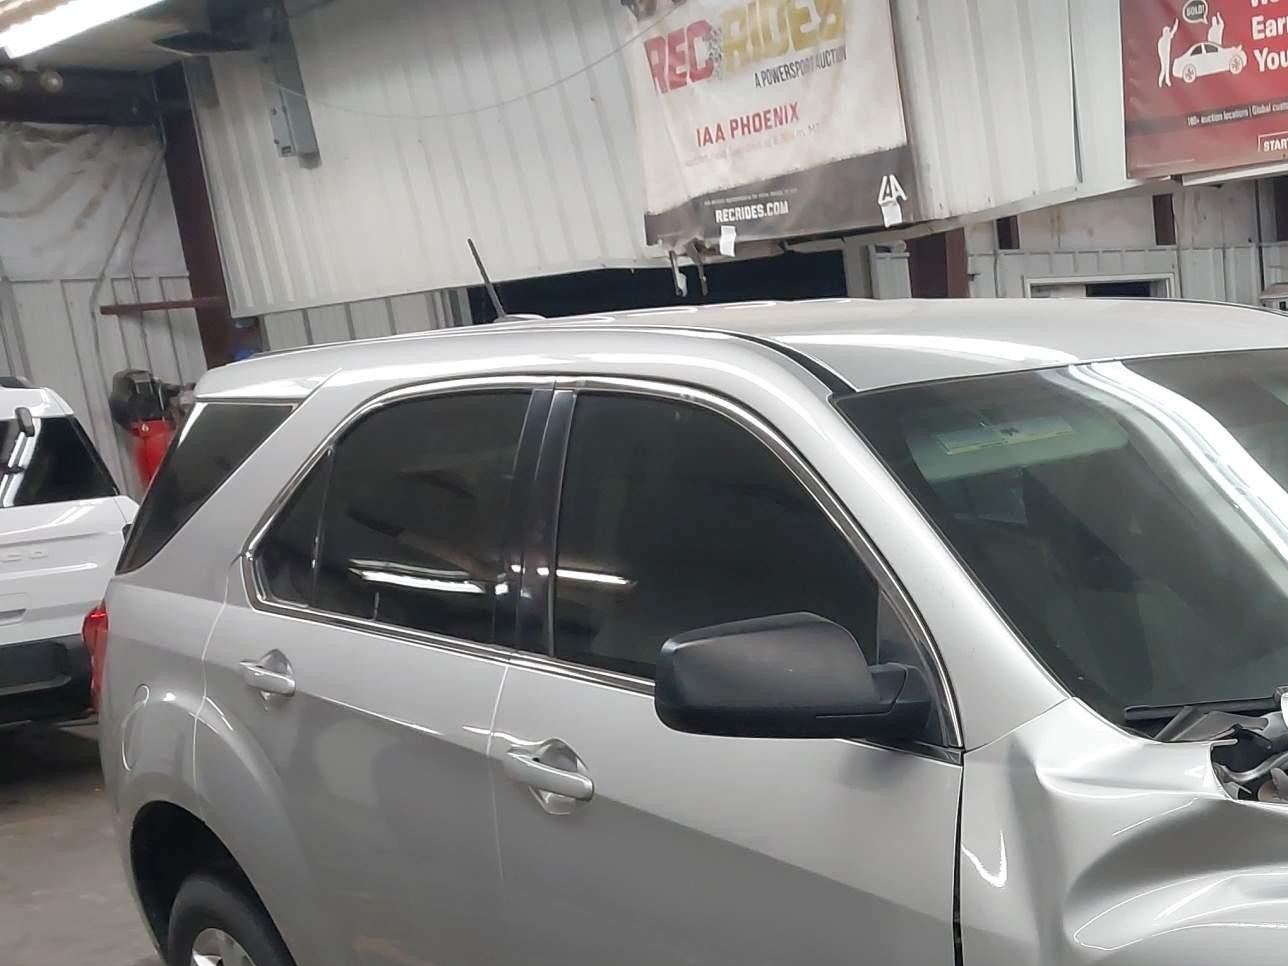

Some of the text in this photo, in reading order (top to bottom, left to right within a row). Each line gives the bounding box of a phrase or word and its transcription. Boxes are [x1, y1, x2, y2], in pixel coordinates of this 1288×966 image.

[754, 72, 762, 88] A
[815, 45, 847, 70] AUCTION
[696, 122, 726, 148] IAA
[729, 101, 800, 139] PHOENIX
[1252, 102, 1271, 115] Global
[714, 200, 789, 223] RECRIDES.COM
